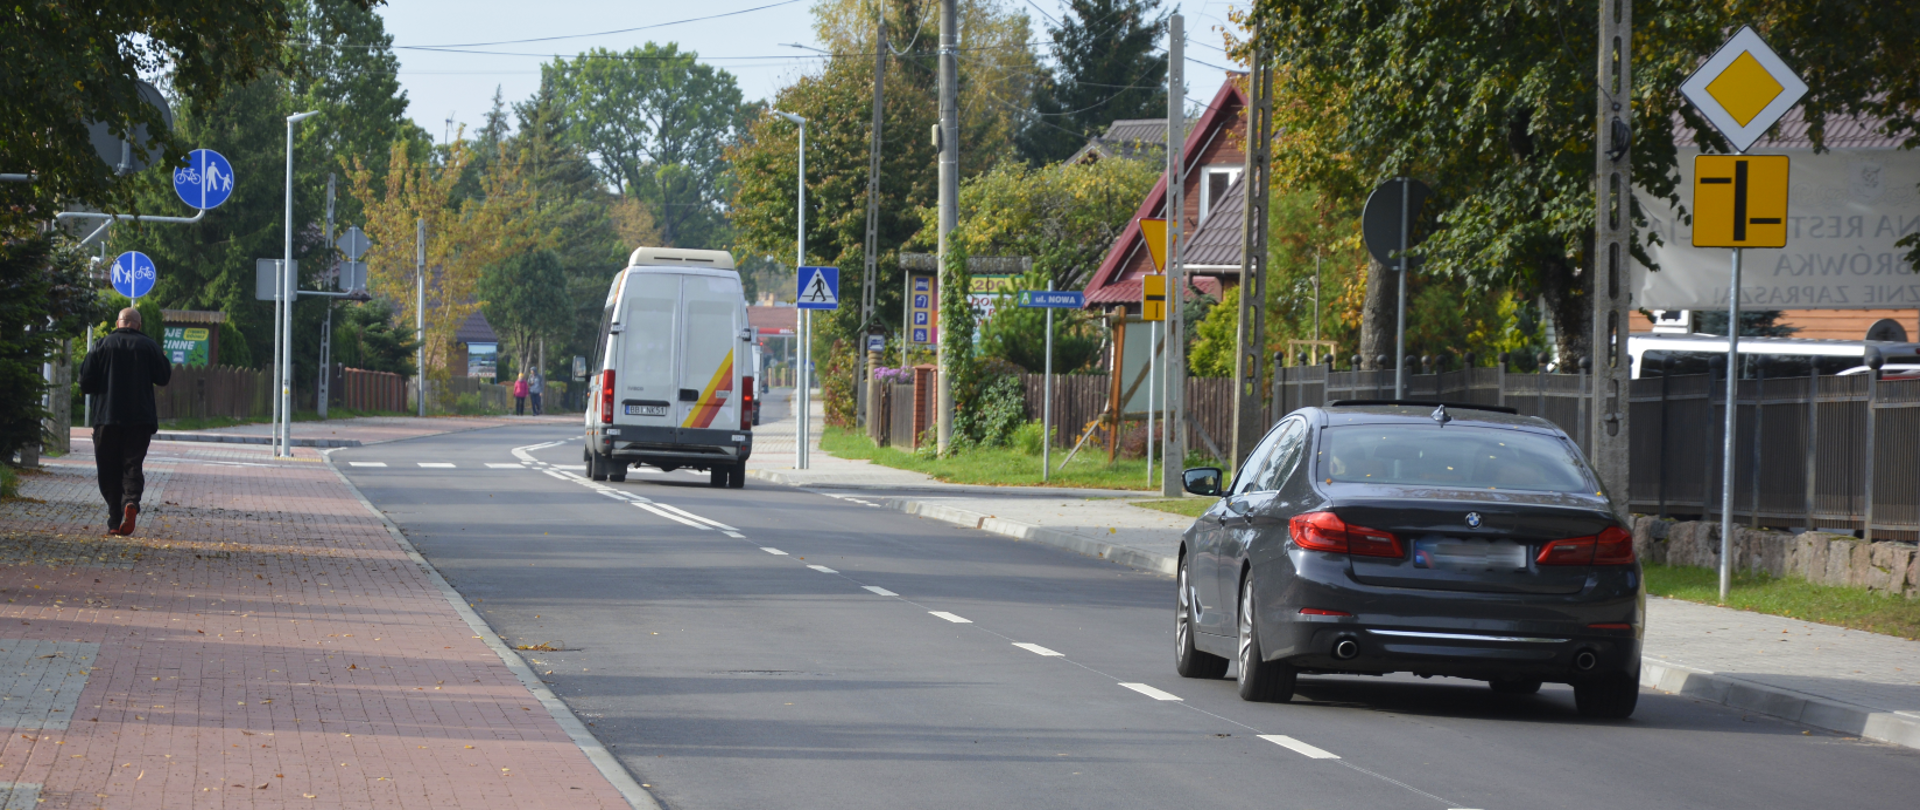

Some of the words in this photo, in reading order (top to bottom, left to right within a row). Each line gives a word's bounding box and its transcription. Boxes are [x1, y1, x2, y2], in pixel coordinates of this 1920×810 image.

[1035, 295, 1046, 303] ul.
[1048, 296, 1076, 304] NOWA
[916, 312, 926, 324] P
